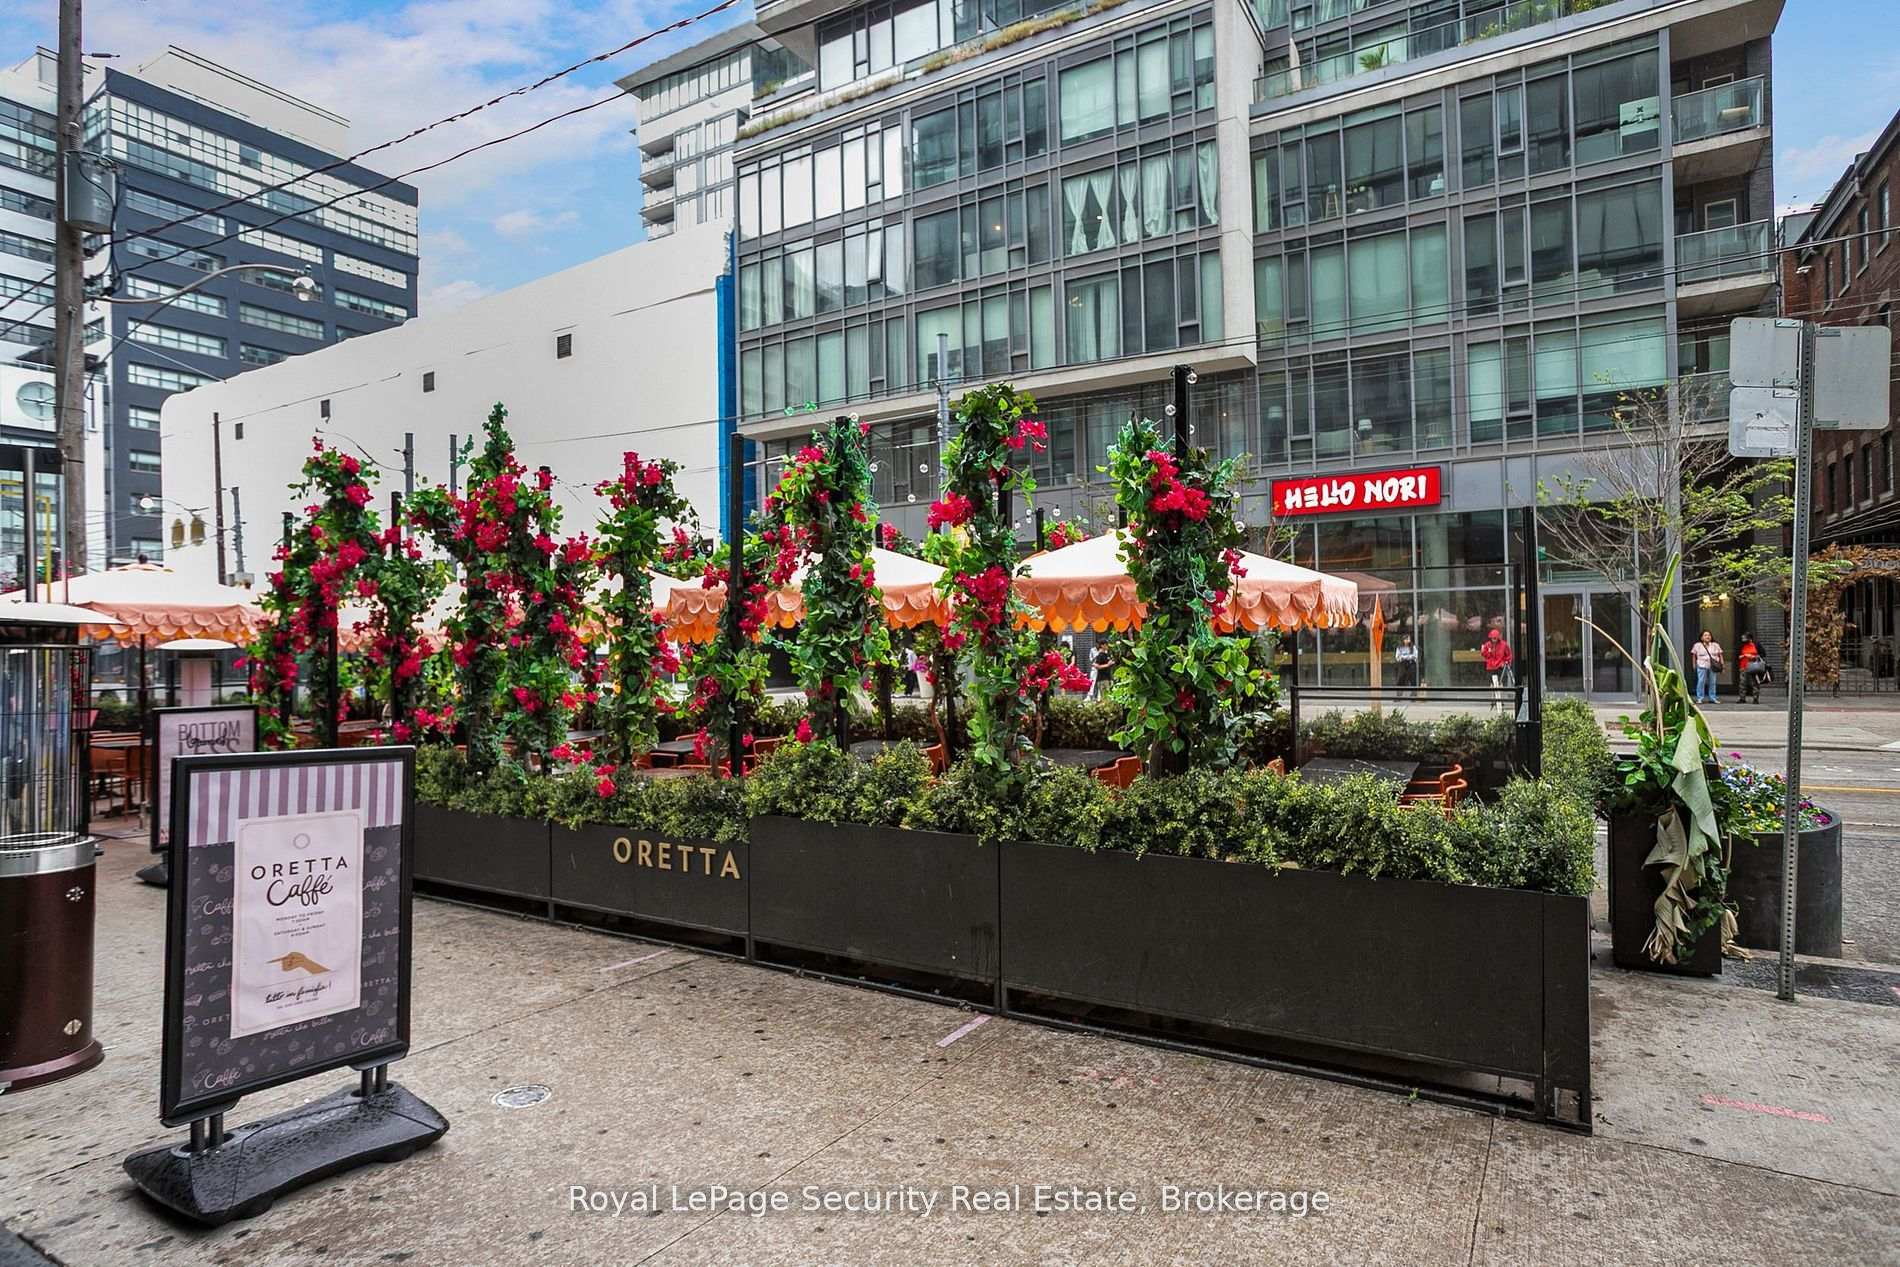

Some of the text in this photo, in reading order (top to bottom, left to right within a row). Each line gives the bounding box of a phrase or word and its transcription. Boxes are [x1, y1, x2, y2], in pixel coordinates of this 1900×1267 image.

[1284, 475, 1427, 509] HELLO NORI
[178, 720, 240, 741] BOTTOM
[251, 856, 348, 880] ORETTA
[612, 837, 741, 879] ORETTA
[267, 874, 333, 906] Caffé
